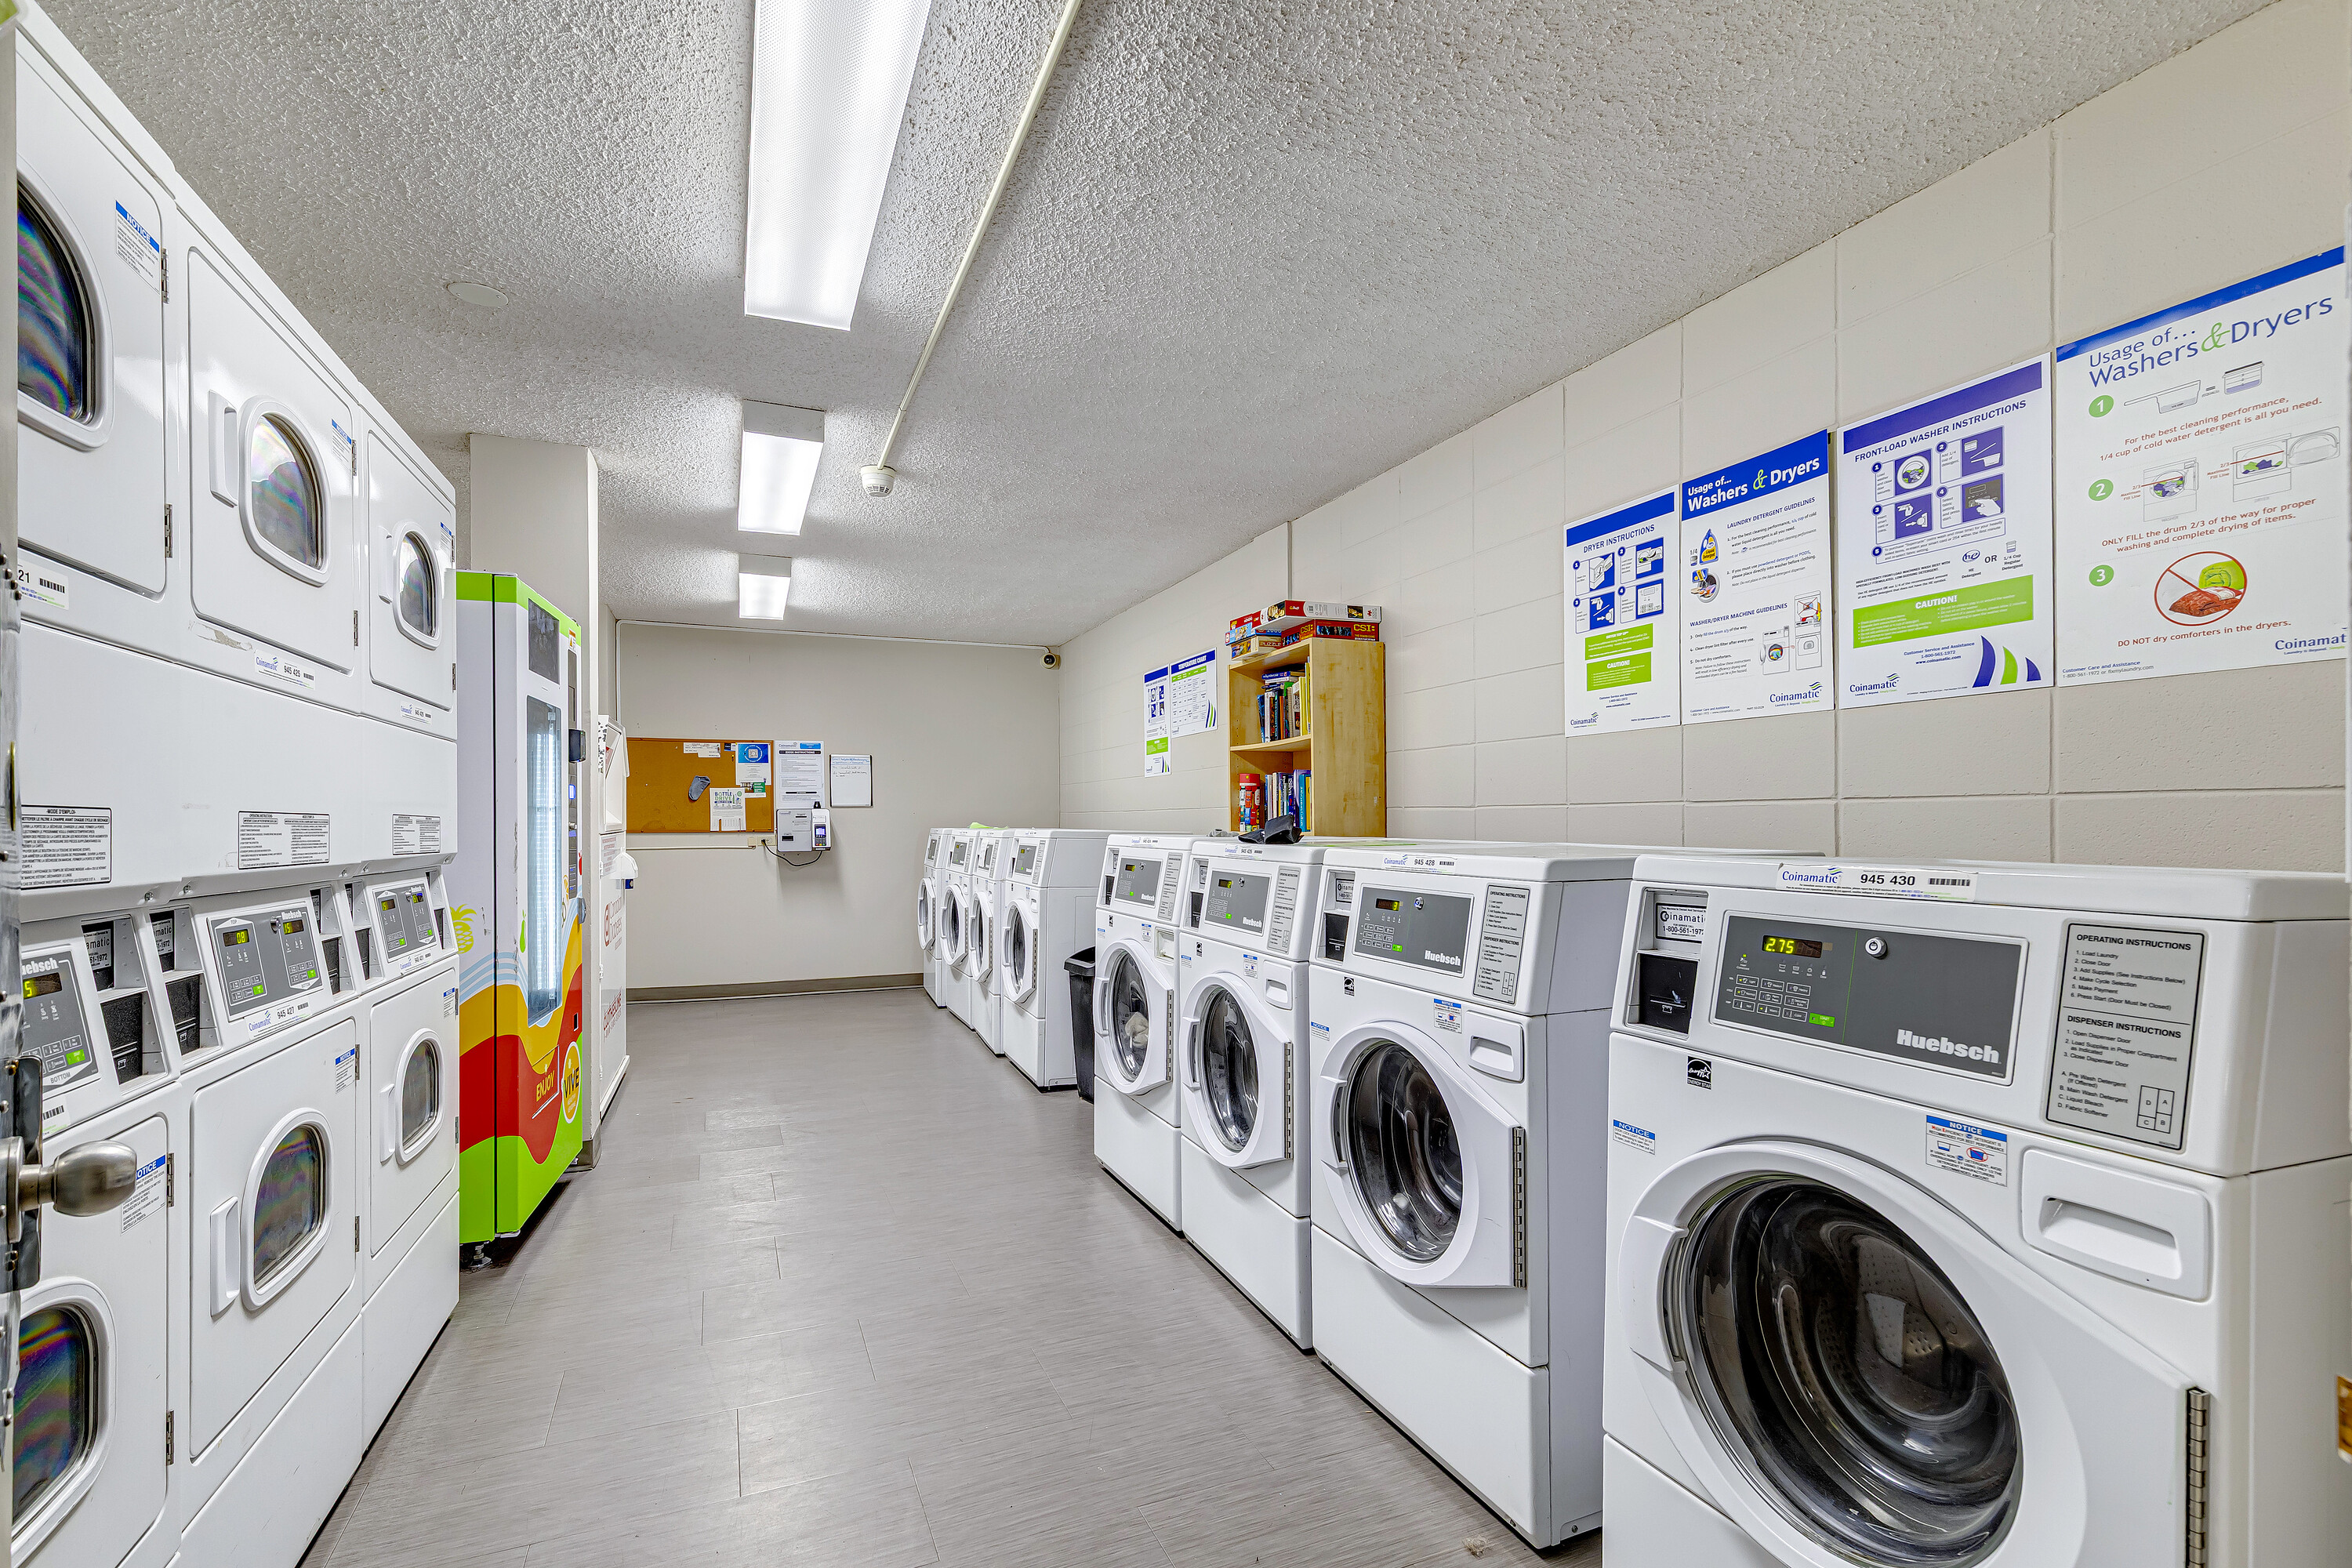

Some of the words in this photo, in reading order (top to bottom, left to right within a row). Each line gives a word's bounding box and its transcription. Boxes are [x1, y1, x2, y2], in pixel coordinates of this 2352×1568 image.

[126, 212, 151, 243] NOTICE
[2089, 341, 2198, 387] Washers
[2201, 322, 2230, 352] &
[2231, 297, 2333, 343] Dryers
[2089, 342, 2144, 368] Usage
[2152, 327, 2196, 347] of...
[2096, 400, 2105, 412] 1
[2158, 426, 2177, 436] best
[2180, 416, 2219, 430] cleaning
[2222, 397, 2289, 421] performance,
[1855, 439, 1907, 463] FRONT-LOAD
[1909, 425, 1949, 444] WASHER
[1952, 400, 2026, 430] INSTRUCTIONS
[2100, 452, 2113, 461] 1/4
[2144, 439, 2162, 449] cold
[2165, 433, 2192, 444] water
[2194, 419, 2241, 437] detergent
[2255, 411, 2267, 420] all
[2270, 407, 2288, 418] you
[2292, 397, 2322, 411] need.
[1688, 484, 1748, 512] Washers
[1753, 470, 1767, 490] &
[1770, 458, 1820, 485] Dryers
[1688, 481, 1713, 495] Usage
[1715, 476, 1731, 487] of...
[2096, 484, 2105, 496] 2
[1727, 517, 1751, 529] LAUNDRY
[1752, 507, 1783, 521] DETERGENT
[1784, 496, 1815, 511] GUIDELINES
[2102, 536, 2124, 546] ONLY
[2126, 533, 2144, 542] FILL
[2163, 525, 2187, 534] drum
[2190, 520, 2205, 532] 2/3
[2209, 517, 2218, 525] of
[2220, 515, 2237, 526] the
[2240, 510, 2262, 519] way
[2261, 506, 2278, 519] for
[2281, 499, 2317, 513] proper
[1584, 540, 1605, 554] DRYER
[1606, 524, 1655, 546] INSTRUCTIONS
[2117, 541, 2151, 552] washing
[2153, 536, 2169, 546] and
[2172, 529, 2215, 542] complete
[2218, 522, 2249, 532] drying
[2265, 514, 2296, 524] items.
[1984, 555, 1997, 564] OR
[2096, 569, 2105, 582] 3
[1915, 595, 1958, 609] CAUTION!
[1690, 615, 1730, 627] WASHER/DRYER
[1730, 609, 1755, 619] MACHINE
[1756, 602, 1788, 614] GUIDELINES
[1300, 624, 1313, 633] CSI:
[2132, 637, 2151, 645] NOT
[2170, 630, 2221, 641] comforters
[2256, 620, 2292, 630] dryers.
[256, 656, 277, 671] Coinamatic
[284, 666, 292, 674] 945
[1607, 660, 1630, 669] CAUTION!
[1915, 655, 1962, 665] www.coinamatic.com
[1849, 681, 1896, 693] Coinamatic
[1769, 690, 1820, 702] Coinamatic
[1782, 871, 1838, 884] Coinamatic
[1860, 874, 1885, 884] 945
[1889, 875, 1915, 886] 430
[1660, 910, 1706, 923] Coinamati
[1766, 938, 1795, 954] 2.75
[2077, 934, 2124, 945] OPERATING
[2125, 938, 2191, 950] INSTRUCTIONS
[21, 958, 59, 975] uebsch
[1425, 950, 1461, 966] Huebsch
[249, 1018, 270, 1032] Coinamatic
[278, 1011, 286, 1019] 945
[2067, 1015, 2114, 1028] DISPENSER
[2116, 1022, 2181, 1038] INSTRUCTIONS
[1896, 1029, 1999, 1064] Huebsch
[50, 1073, 70, 1083] BOTTOM
[536, 1070, 554, 1102] ENJOY
[1619, 1122, 1650, 1138] NOTICE
[1950, 1123, 1982, 1134] NOTICE
[136, 1161, 157, 1178] OTICE
